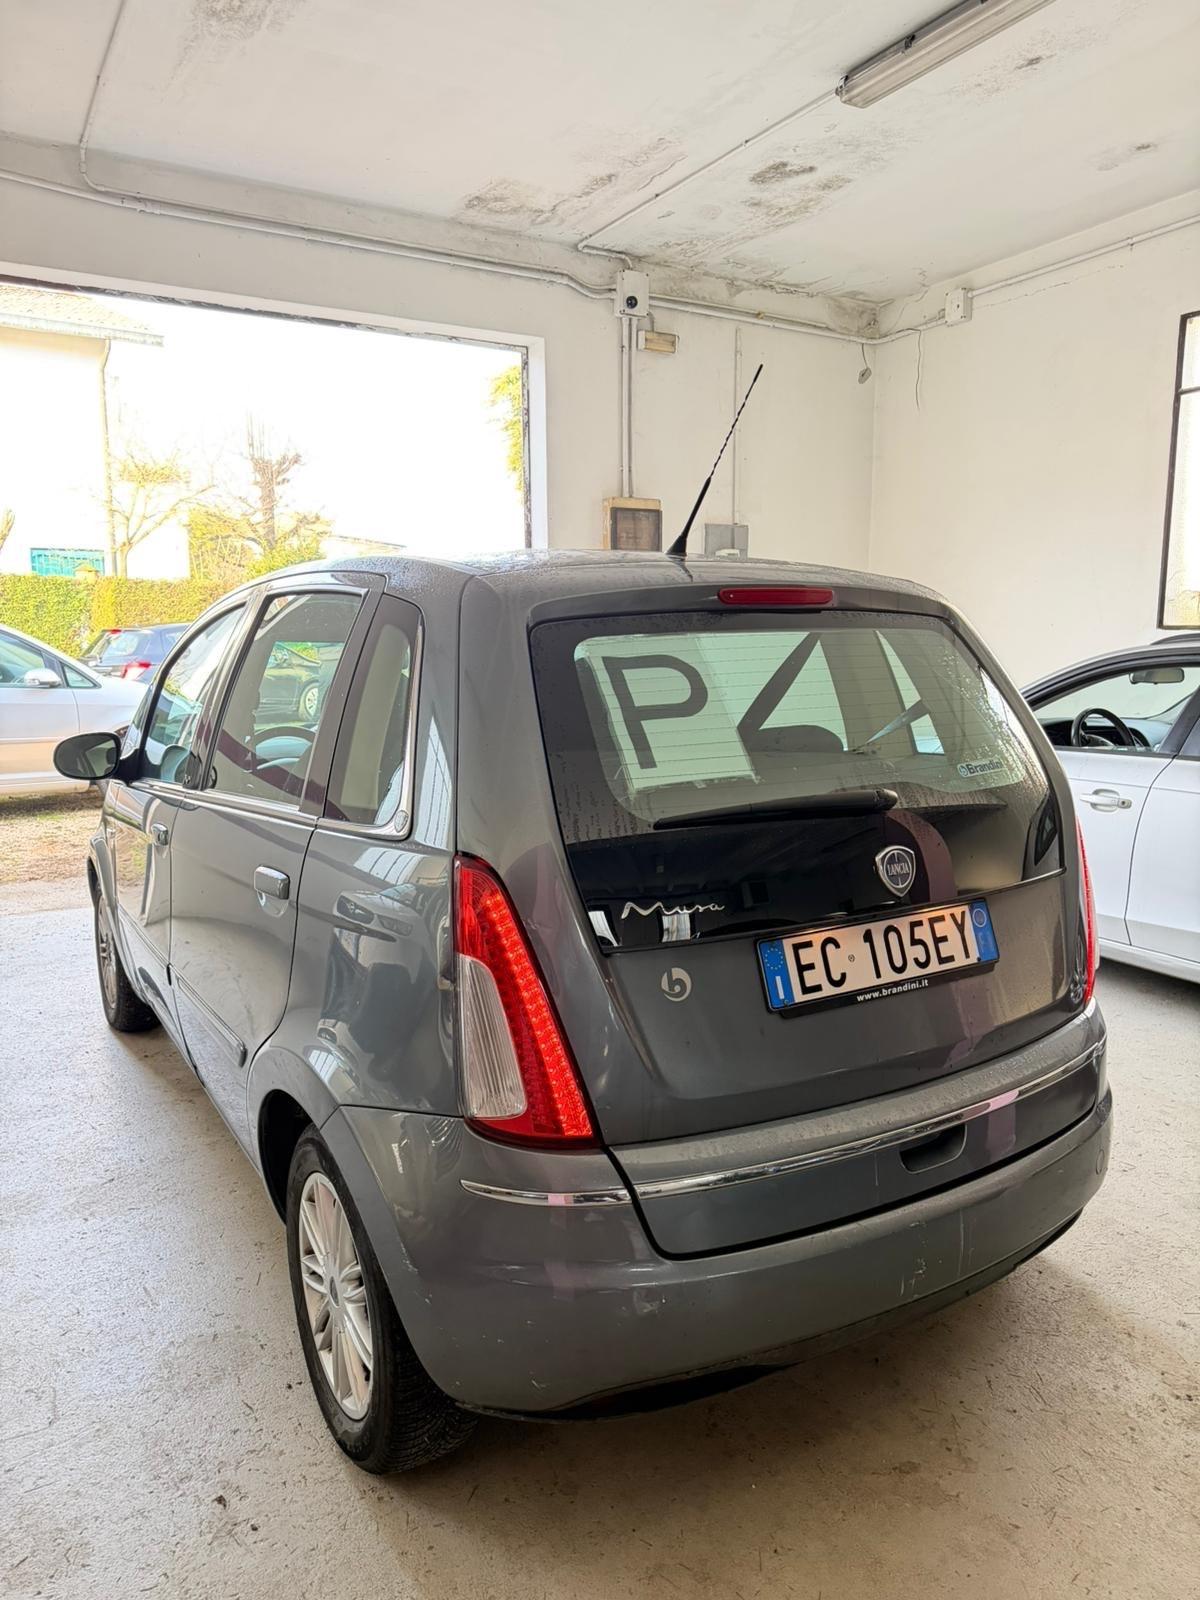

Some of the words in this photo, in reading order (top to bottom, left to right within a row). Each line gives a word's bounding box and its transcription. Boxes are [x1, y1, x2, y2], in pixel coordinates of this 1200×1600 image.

[887, 862, 910, 876] LANCIA
[621, 901, 725, 919] Musa
[792, 936, 848, 996] EC
[862, 910, 970, 980] 105EY
[857, 979, 929, 1002] www.brandini.it
